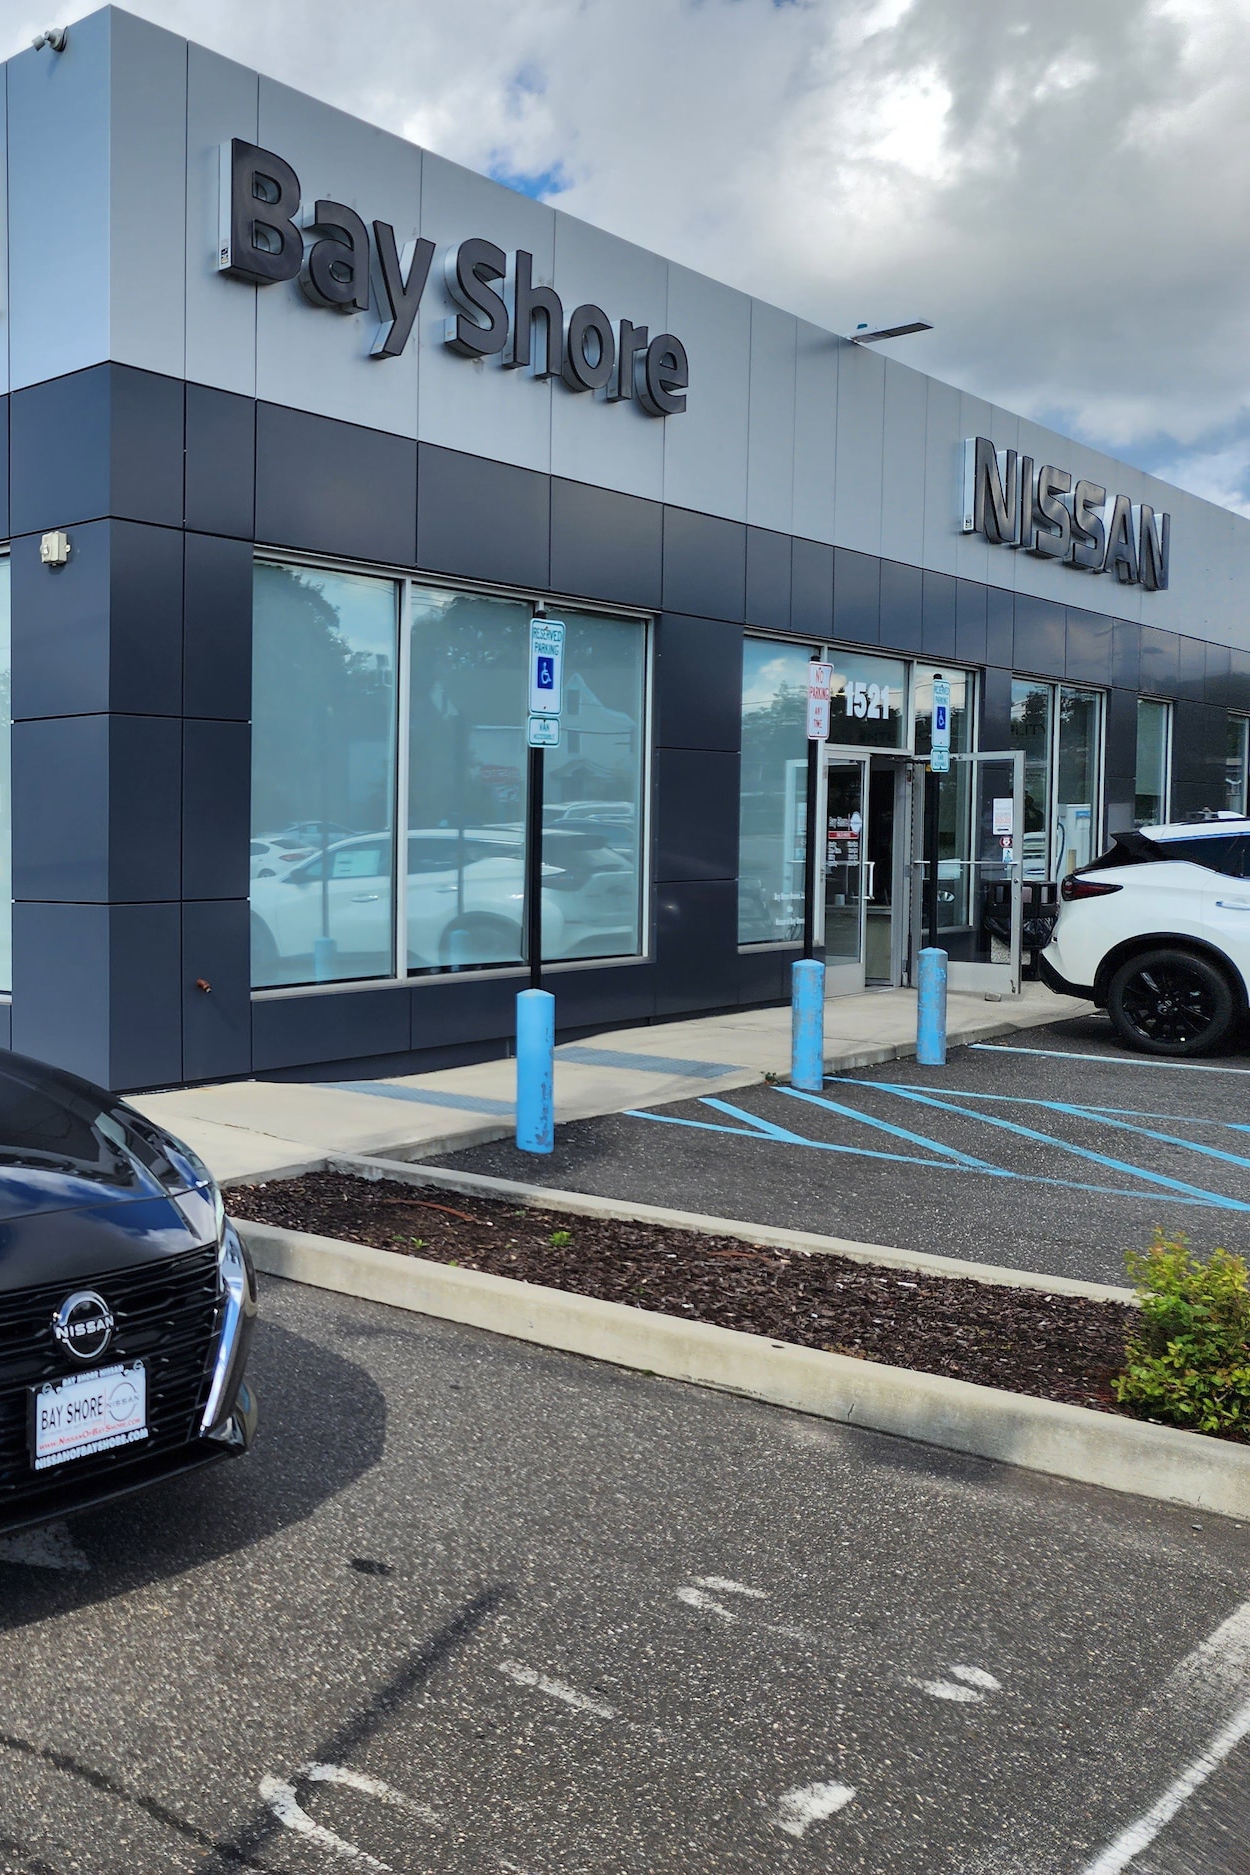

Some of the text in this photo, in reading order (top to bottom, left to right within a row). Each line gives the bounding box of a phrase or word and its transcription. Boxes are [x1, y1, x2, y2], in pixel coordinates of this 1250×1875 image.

[220, 137, 689, 416] Bay Shore
[966, 436, 1171, 590] NISSAN
[533, 627, 563, 642] RESERVED
[534, 641, 560, 656] PARKING
[815, 669, 824, 684] NO
[809, 687, 829, 700] PARKING
[844, 681, 890, 720] 1521
[814, 706, 823, 715] ANY
[539, 722, 550, 732] VAN
[814, 718, 823, 729] TIME
[56, 1315, 115, 1340] NISSAN
[107, 1395, 140, 1409] NISSAN
[41, 1405, 63, 1430] BAY
[67, 1395, 103, 1424] SHORE
[35, 1427, 149, 1470] NISSANOFBAYSHORE.COM
